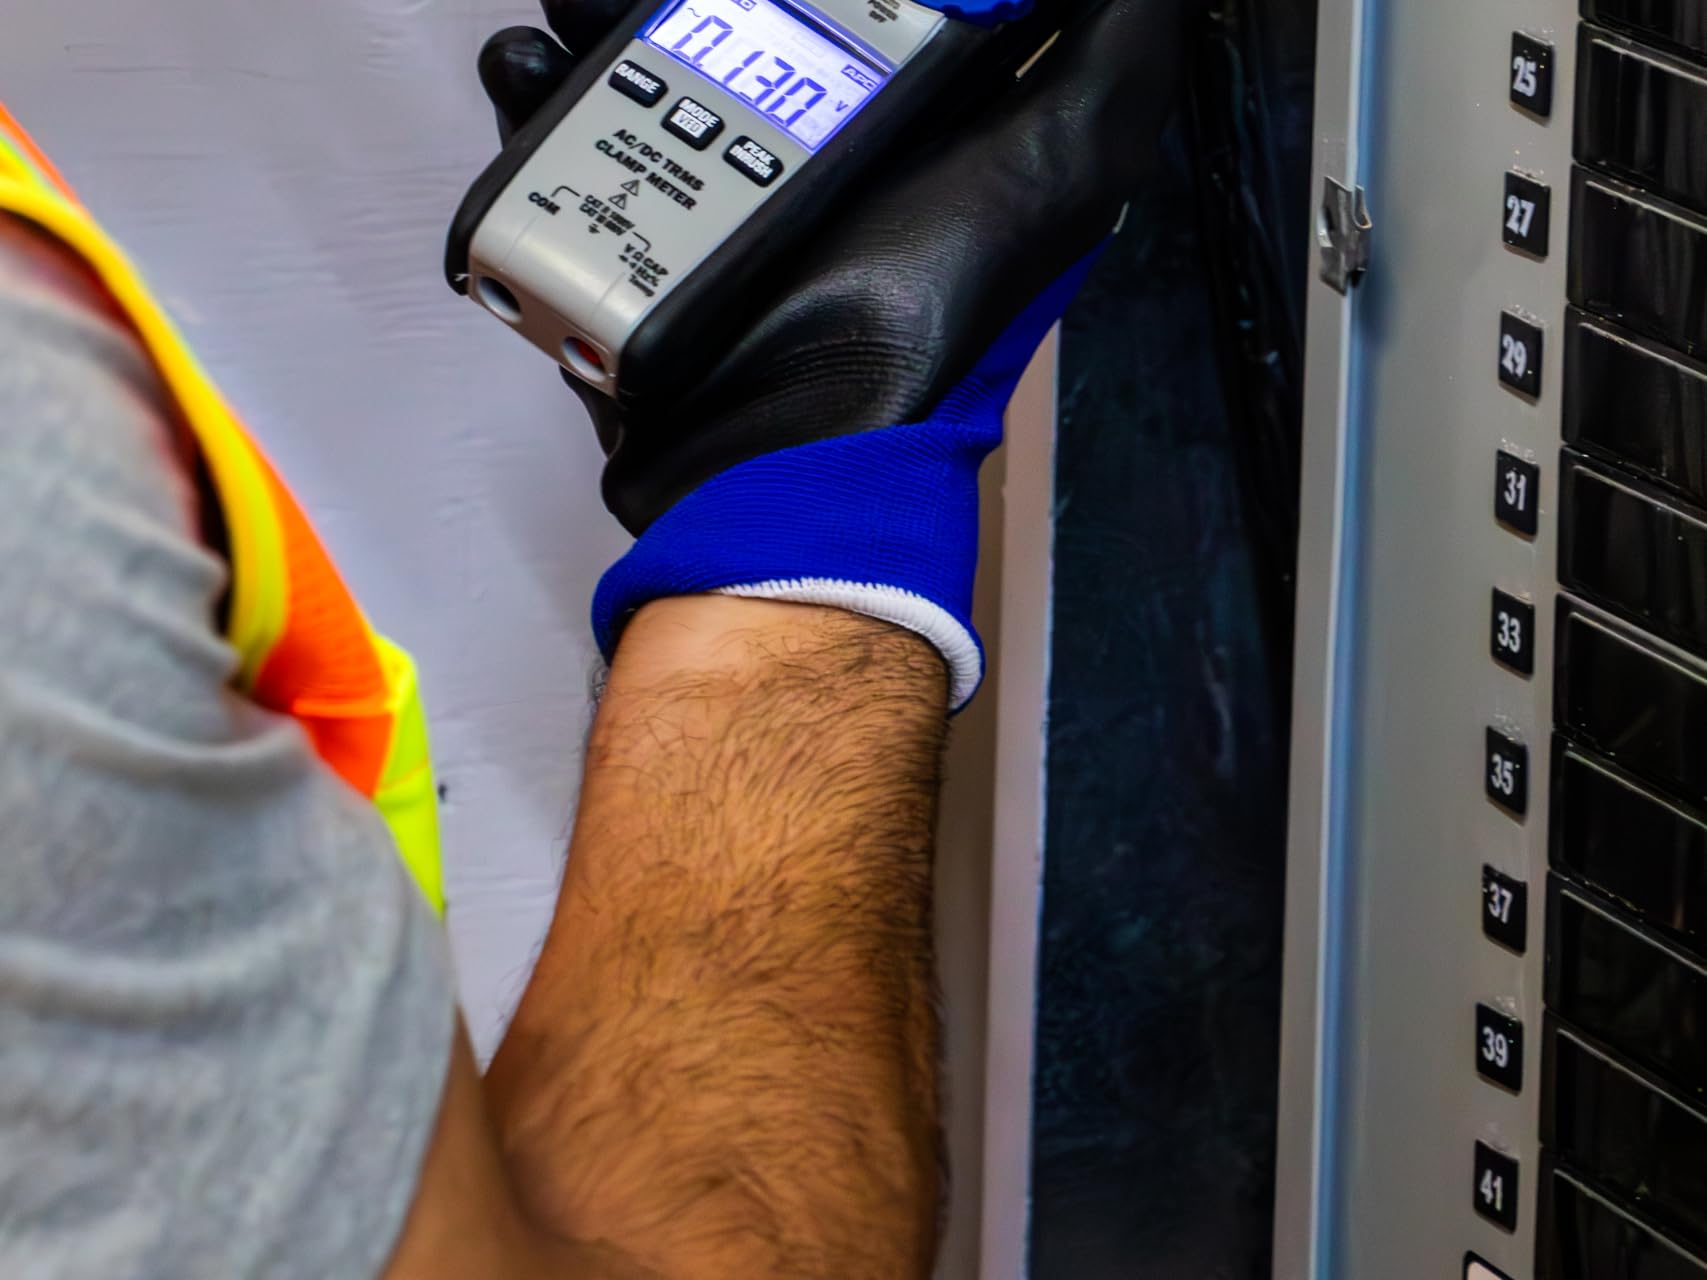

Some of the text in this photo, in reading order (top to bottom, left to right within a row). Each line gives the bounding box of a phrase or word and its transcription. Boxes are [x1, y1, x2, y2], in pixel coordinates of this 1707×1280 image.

[614, 58, 661, 94] RANGE
[1513, 56, 1536, 97] 25
[678, 98, 720, 128] MODE
[612, 128, 705, 192] AC/DC TRMS
[743, 140, 776, 166] PEAK
[594, 139, 697, 211] CLAMP METER
[528, 191, 561, 216] COM
[1506, 195, 1535, 237] 27
[642, 257, 669, 276] CAP
[1502, 334, 1527, 377] 29
[1504, 471, 1526, 511] 31
[1498, 612, 1520, 653] 33
[1492, 754, 1513, 795] 35
[1488, 881, 1513, 924] 37
[1483, 1027, 1507, 1067] 39
[1481, 1171, 1501, 1210] 41
